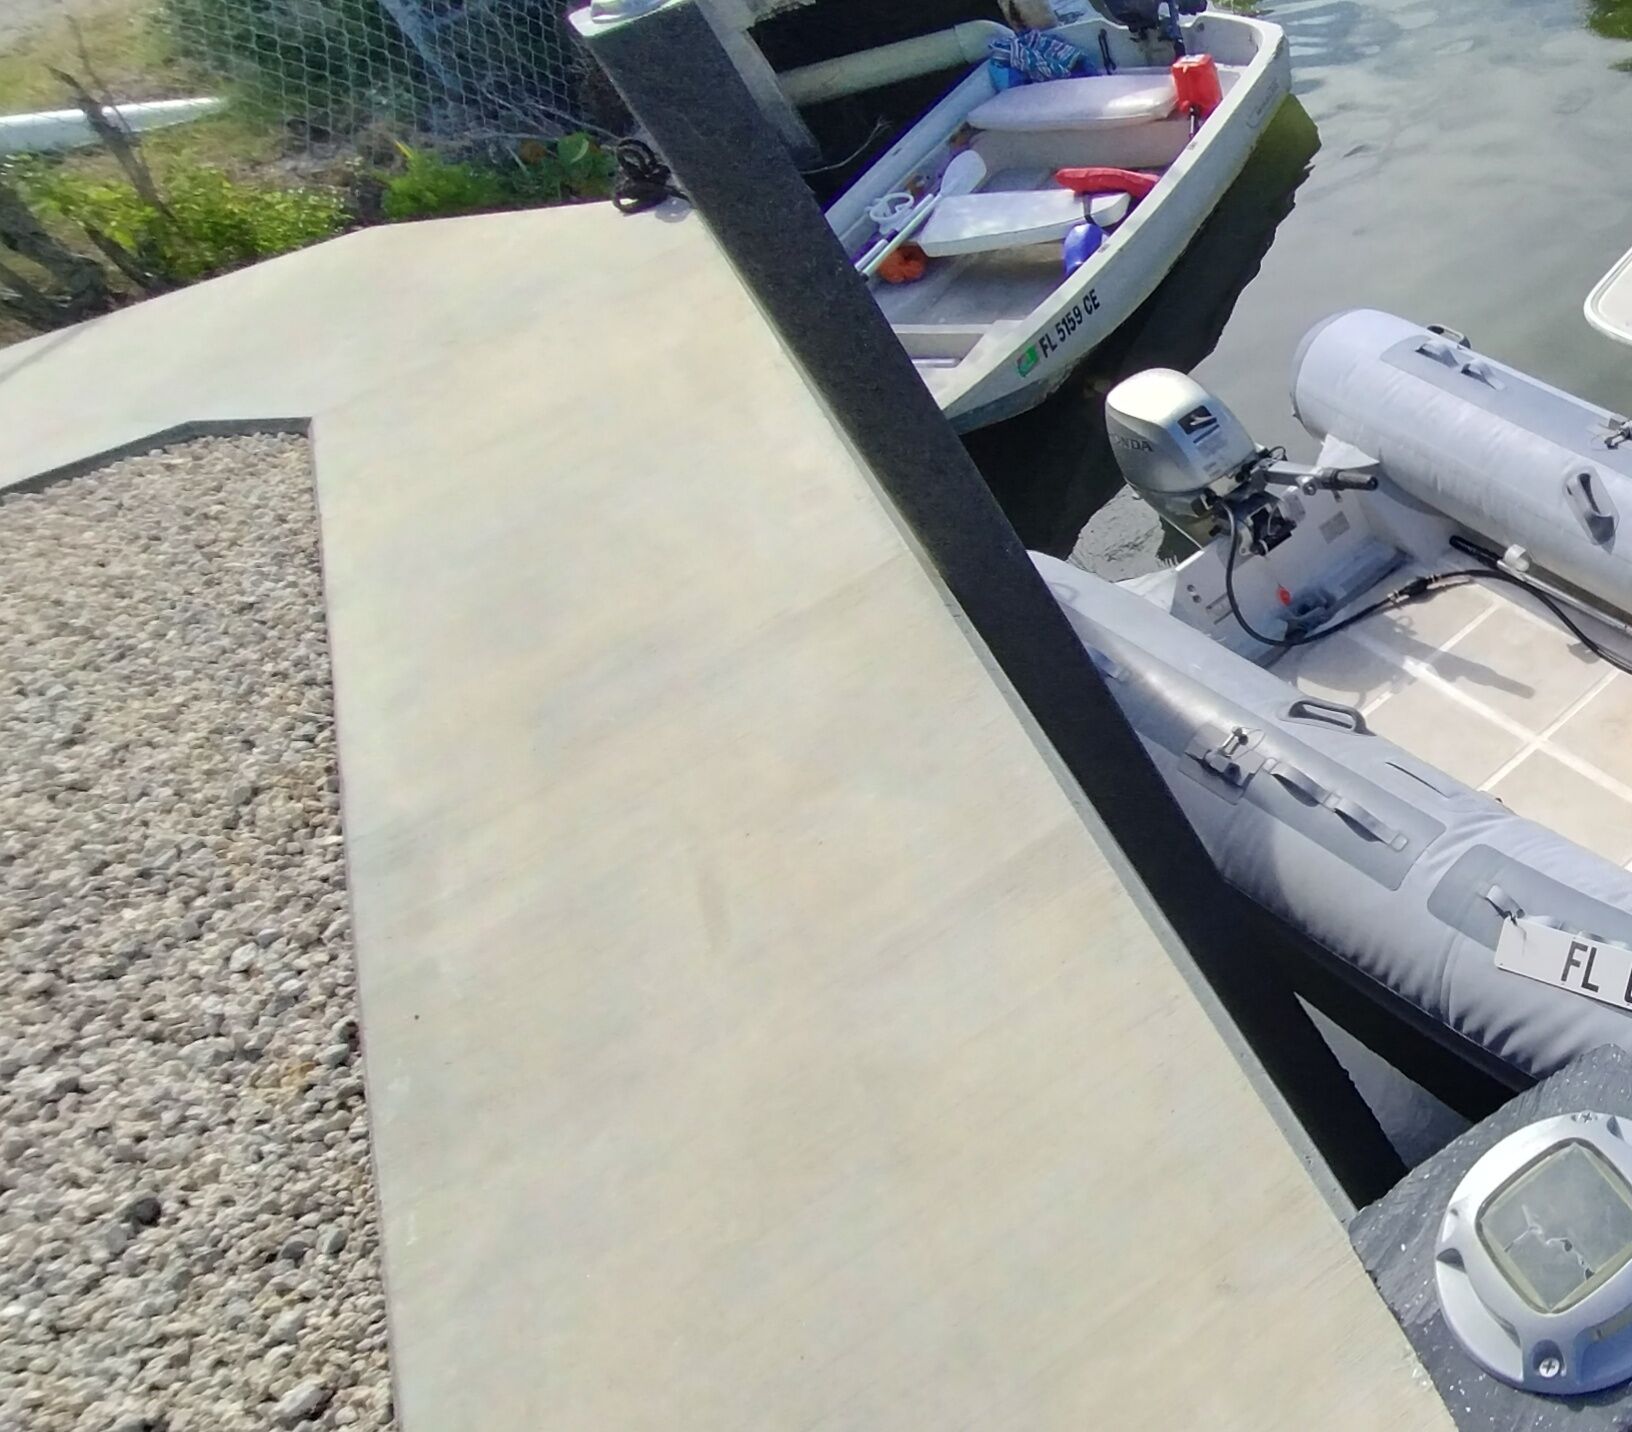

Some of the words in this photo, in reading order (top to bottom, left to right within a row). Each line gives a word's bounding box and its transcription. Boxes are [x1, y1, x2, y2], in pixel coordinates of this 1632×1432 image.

[1039, 333, 1057, 358] FL
[1055, 305, 1082, 342] 5159
[1083, 288, 1100, 315] CE
[1561, 941, 1599, 992] FL
